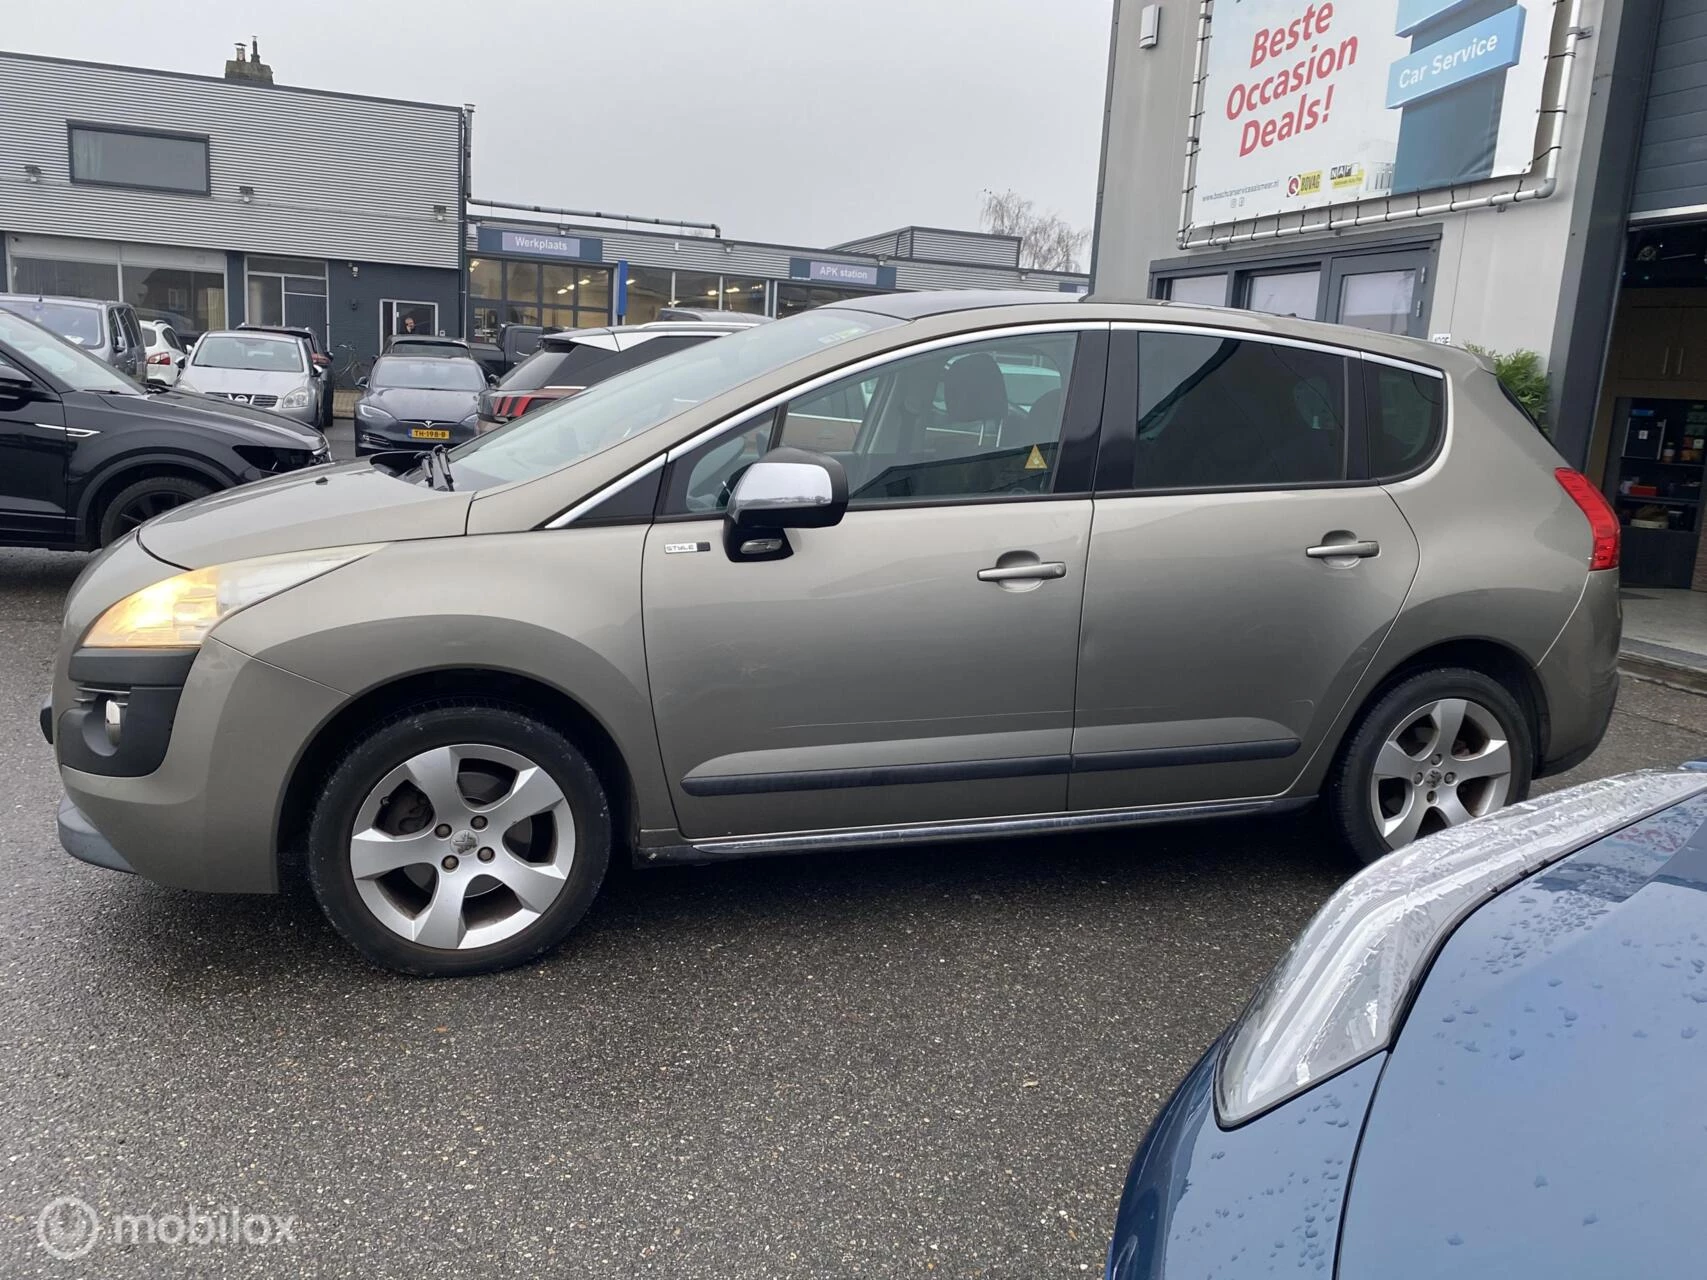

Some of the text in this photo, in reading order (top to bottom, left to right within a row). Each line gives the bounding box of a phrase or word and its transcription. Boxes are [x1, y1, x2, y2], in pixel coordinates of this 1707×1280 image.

[1250, 2, 1334, 69] Beste
[1399, 34, 1498, 88] Car Service
[1226, 36, 1358, 120] Occasion
[1239, 84, 1334, 157] Deals!
[1300, 174, 1320, 191] BOVAG
[514, 236, 568, 251] Werkplaats
[819, 266, 868, 279] APK station
